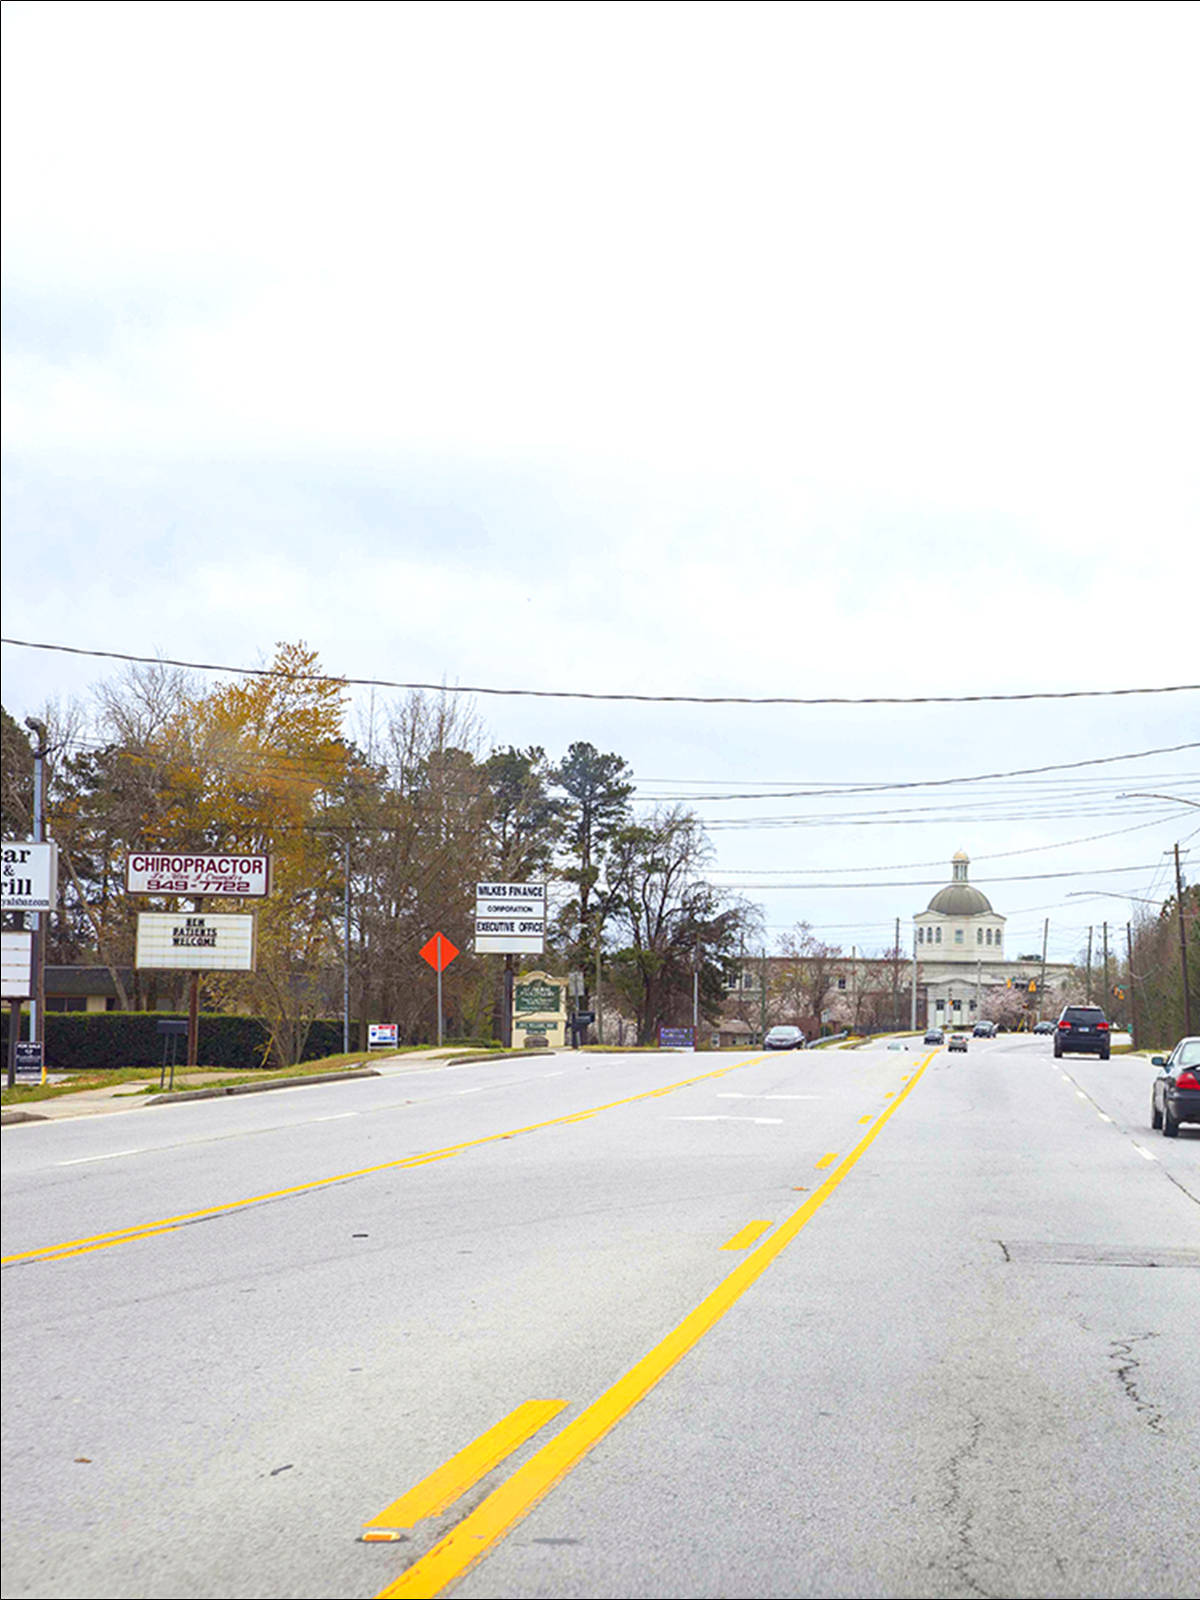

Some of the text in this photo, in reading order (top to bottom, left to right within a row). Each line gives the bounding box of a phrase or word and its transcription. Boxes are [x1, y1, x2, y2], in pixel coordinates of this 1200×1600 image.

[1, 849, 31, 863] ar
[3, 865, 15, 877] &
[132, 857, 263, 874] CHIROPRACTOR
[1, 878, 32, 895] rill
[147, 880, 251, 892] 949-7722
[478, 886, 543, 897] WILKES FINANCE
[172, 928, 217, 937] PATIENTS
[477, 921, 543, 933] EXECUTIVE OFFICE
[172, 938, 216, 947] WELCOME
